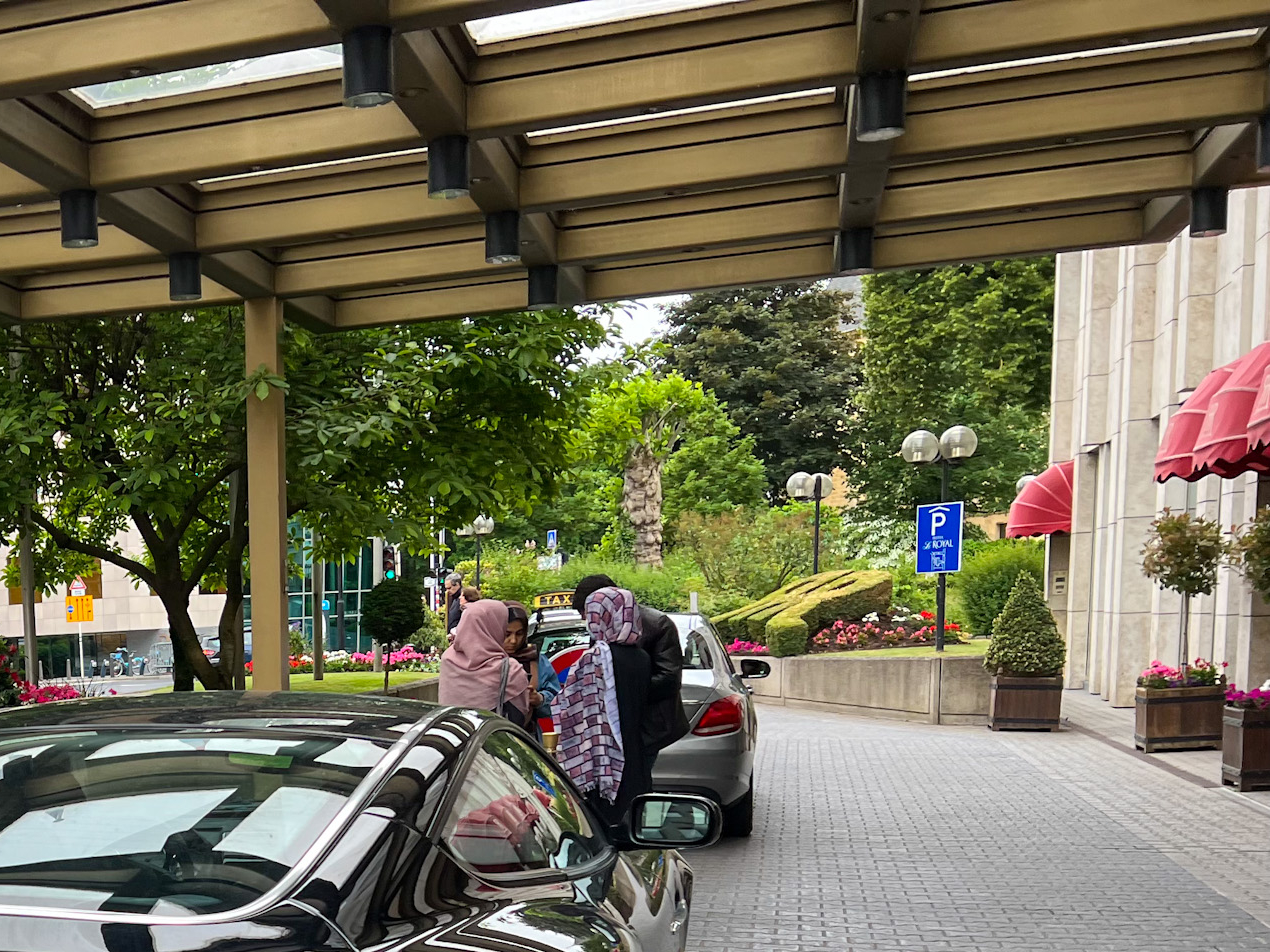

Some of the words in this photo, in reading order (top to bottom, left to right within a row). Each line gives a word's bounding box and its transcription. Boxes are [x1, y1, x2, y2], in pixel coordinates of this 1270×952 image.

[931, 512, 947, 536] P
[932, 539, 953, 549] ROYAL
[545, 594, 571, 605] TAX
